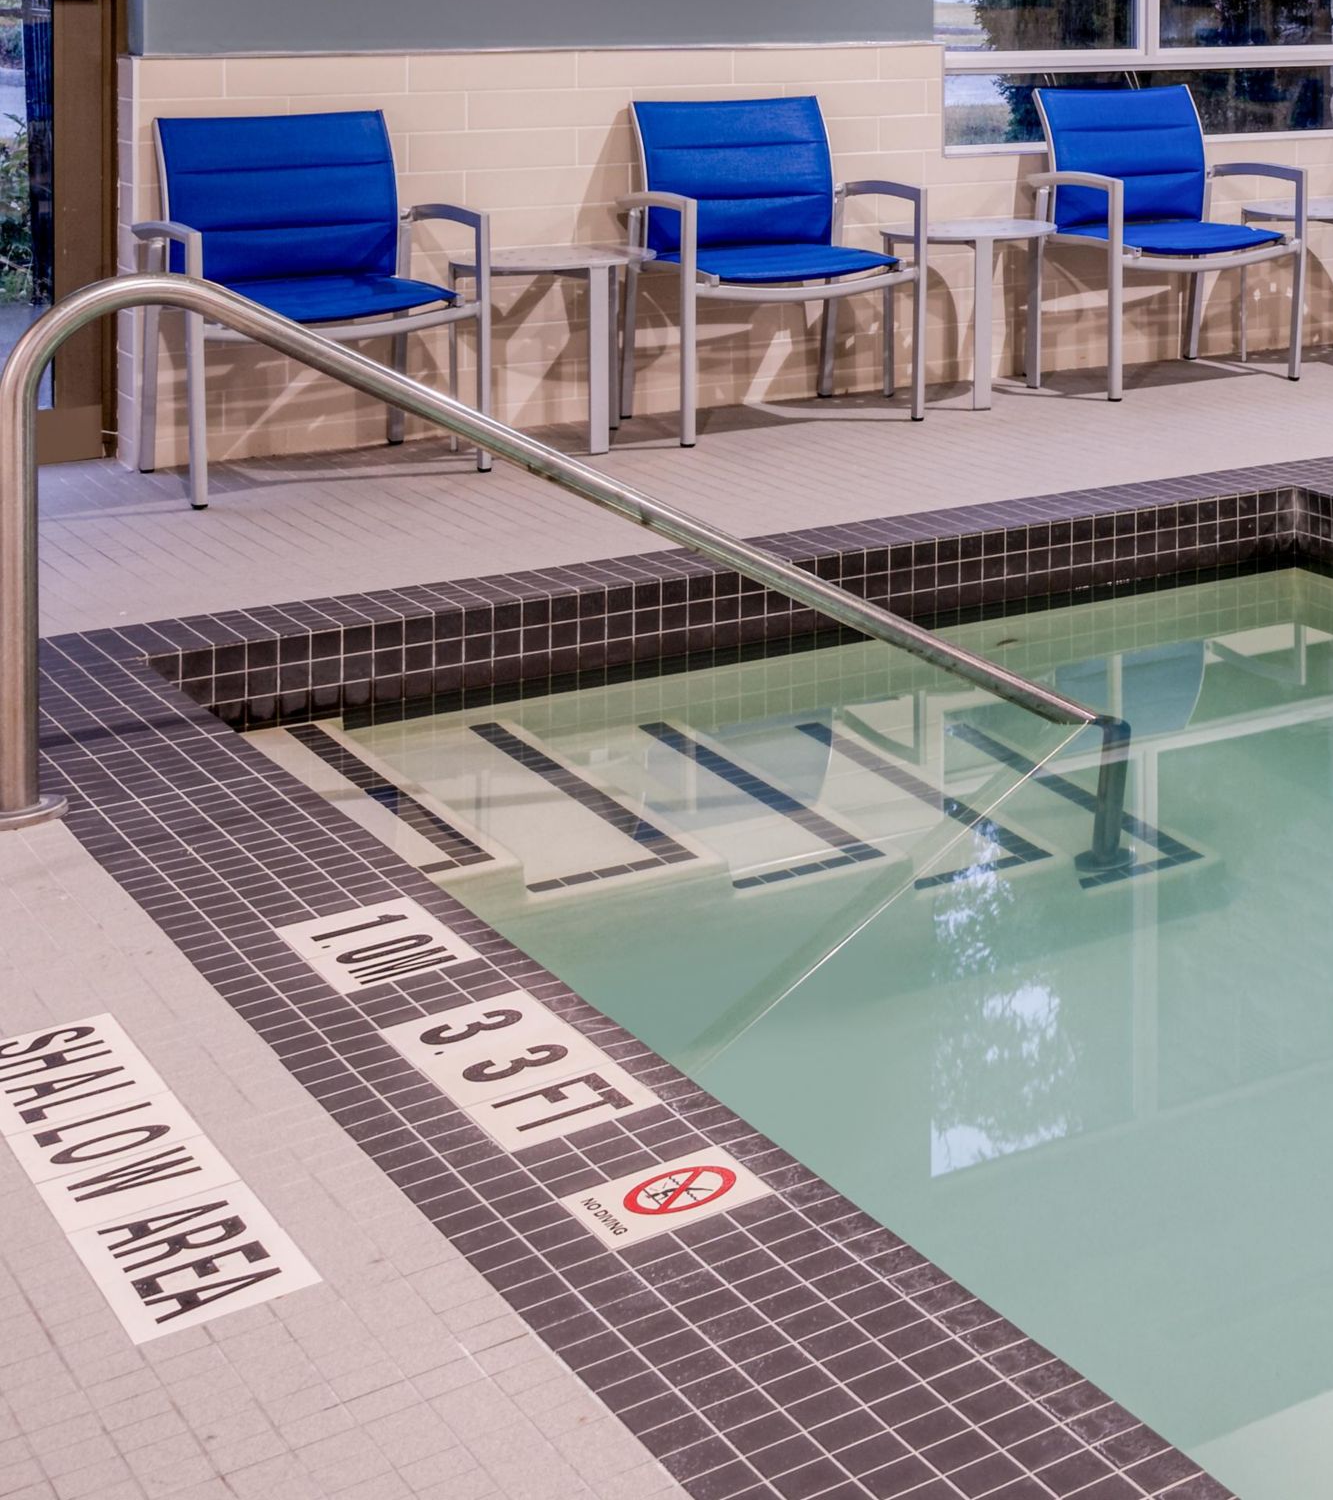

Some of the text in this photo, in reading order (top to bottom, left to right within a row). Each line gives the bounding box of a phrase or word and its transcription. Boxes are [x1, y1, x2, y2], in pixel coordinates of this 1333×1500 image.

[491, 1072, 634, 1132] FT
[0, 1026, 283, 1325] SHALLOW AREA
[580, 1197, 628, 1236] NO DIVING
